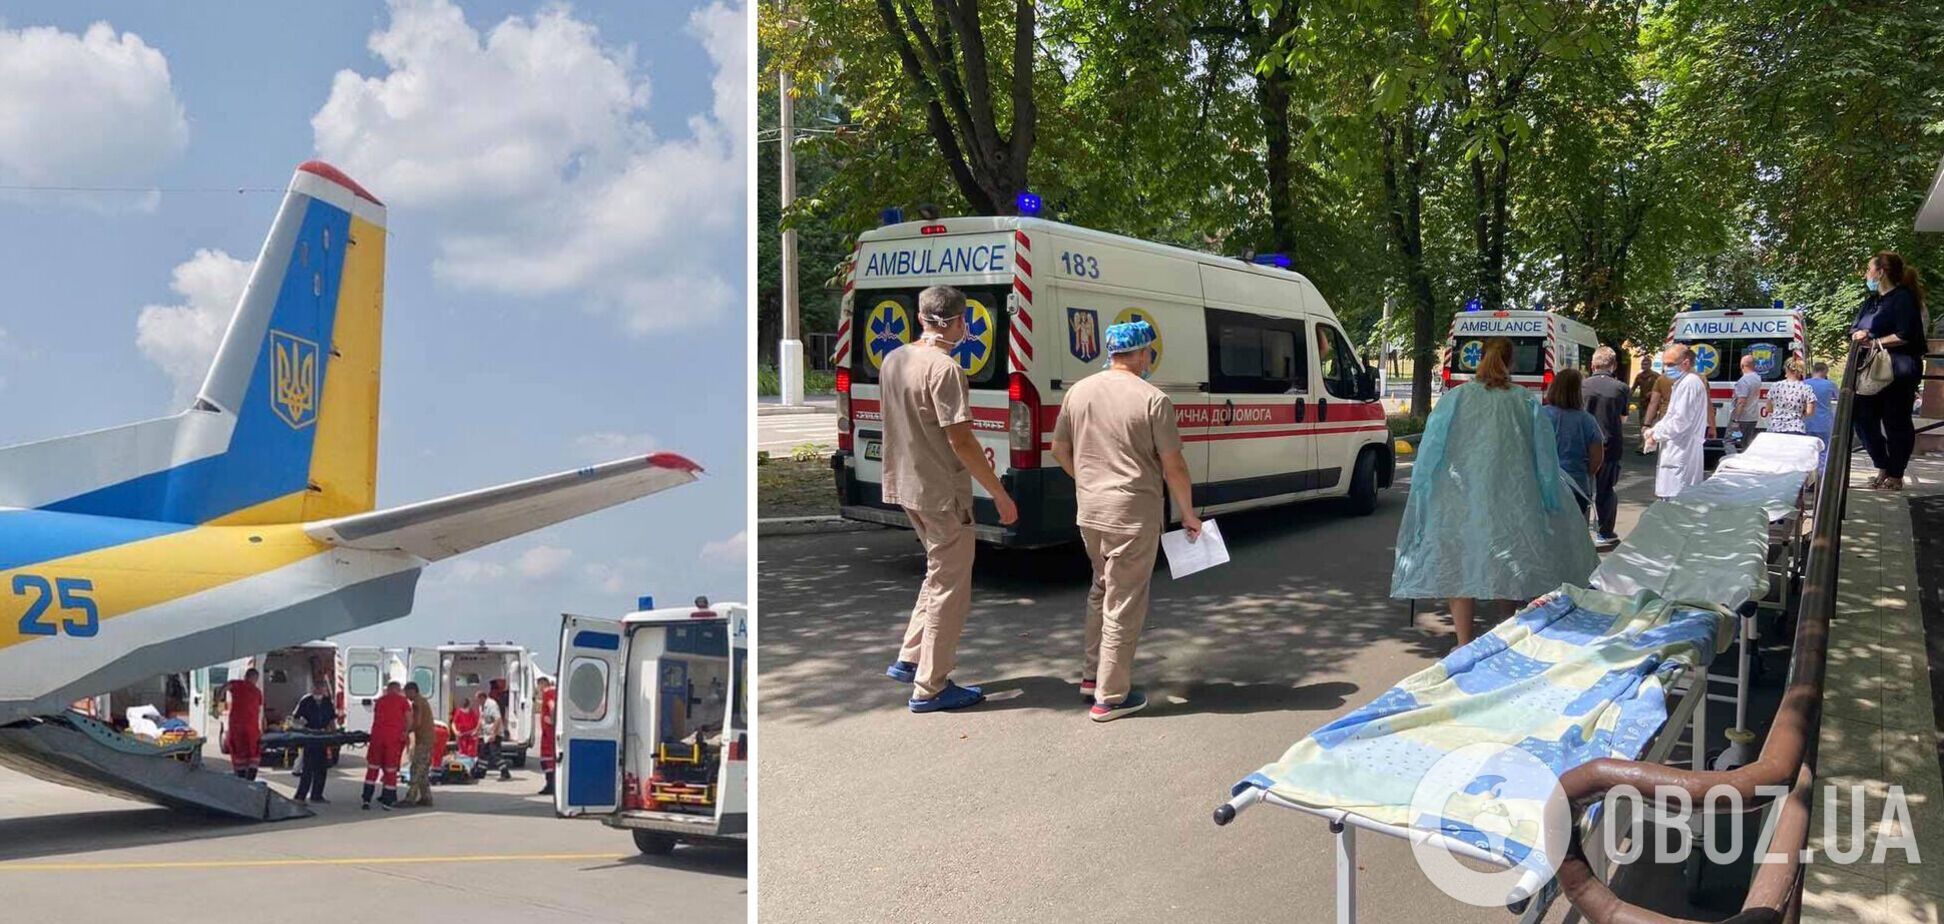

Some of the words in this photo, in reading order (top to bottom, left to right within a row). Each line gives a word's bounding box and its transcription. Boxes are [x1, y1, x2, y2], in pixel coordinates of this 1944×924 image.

[865, 245, 1007, 277] AMBULANCE
[1061, 251, 1100, 279] 183
[1460, 320, 1542, 333] AMBULANCE
[1682, 320, 1788, 334] AMBULANCE
[12, 574, 99, 637] 25
